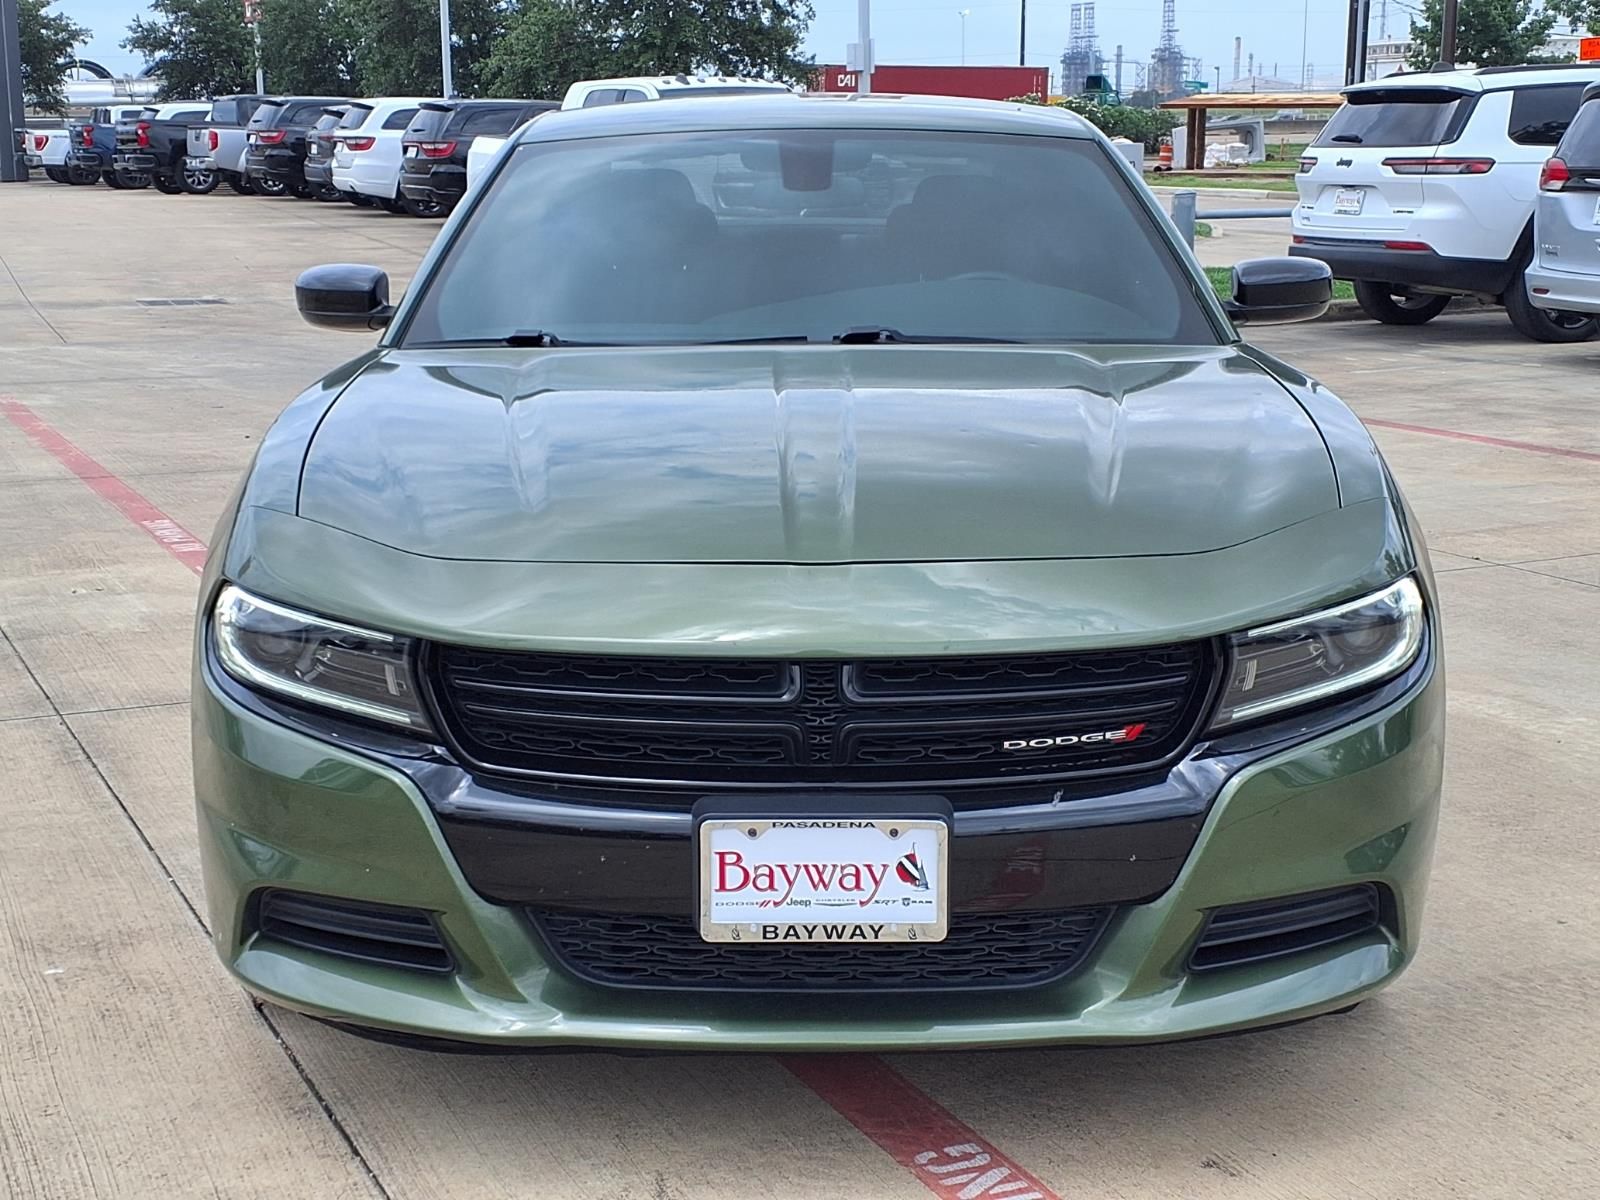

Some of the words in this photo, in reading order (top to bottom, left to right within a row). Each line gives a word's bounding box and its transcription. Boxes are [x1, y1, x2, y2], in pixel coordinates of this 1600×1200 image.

[837, 74, 856, 87] CAI
[1003, 729, 1127, 750] DODGE
[771, 821, 876, 829] PASADENA
[714, 851, 890, 908] Bayway
[786, 897, 812, 908] Jeep
[762, 925, 885, 940] BAYWAY
